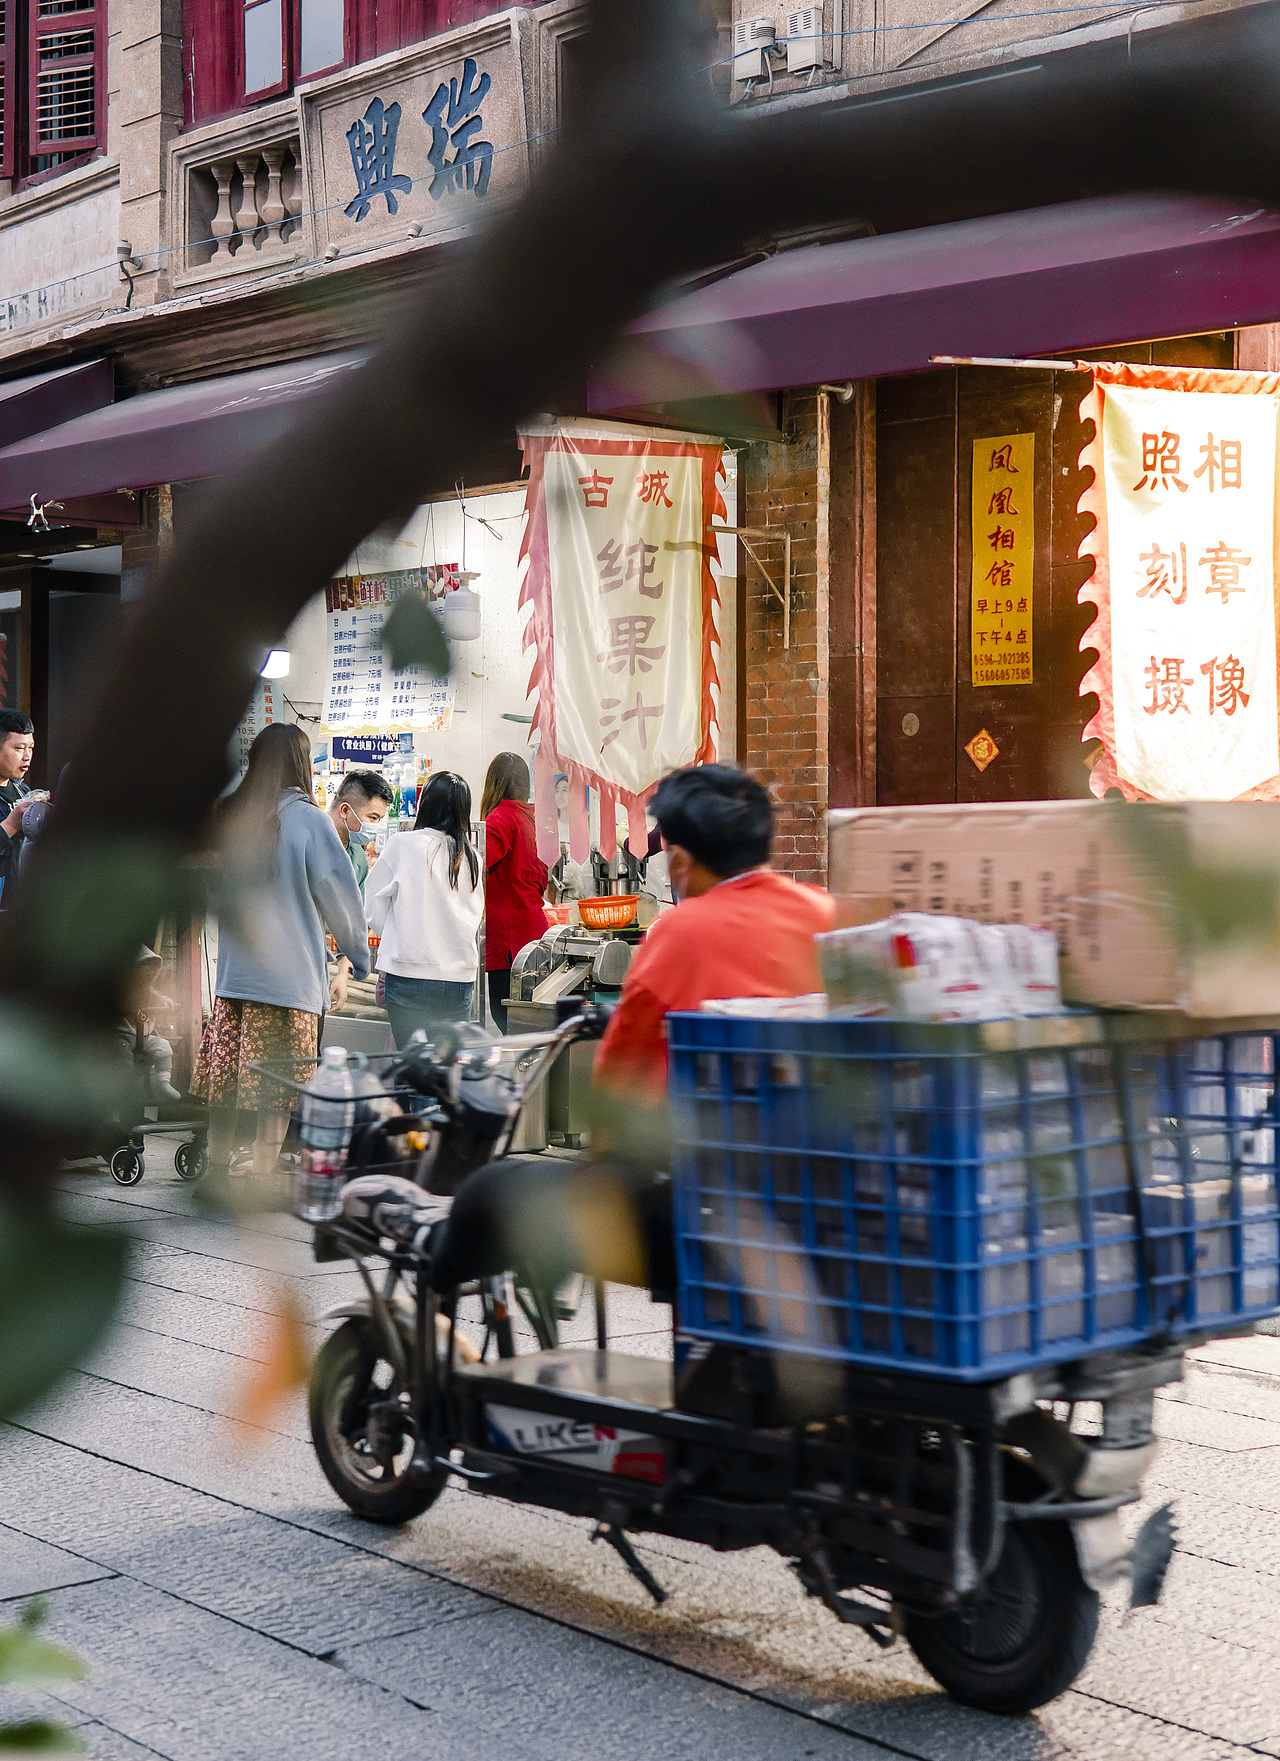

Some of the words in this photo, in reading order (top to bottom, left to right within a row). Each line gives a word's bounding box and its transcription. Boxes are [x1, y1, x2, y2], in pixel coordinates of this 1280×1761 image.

[578, 469, 674, 508] 古城
[1133, 431, 1242, 493] 照相
[984, 444, 1020, 588] 凤凰相馆
[1136, 541, 1252, 605] 刻章
[976, 597, 1028, 614] 早上9点
[596, 537, 665, 751] 纯果汁
[976, 628, 1028, 646] 下午4点
[974, 668, 1031, 682] 15606057589
[1143, 653, 1251, 716] 摄像
